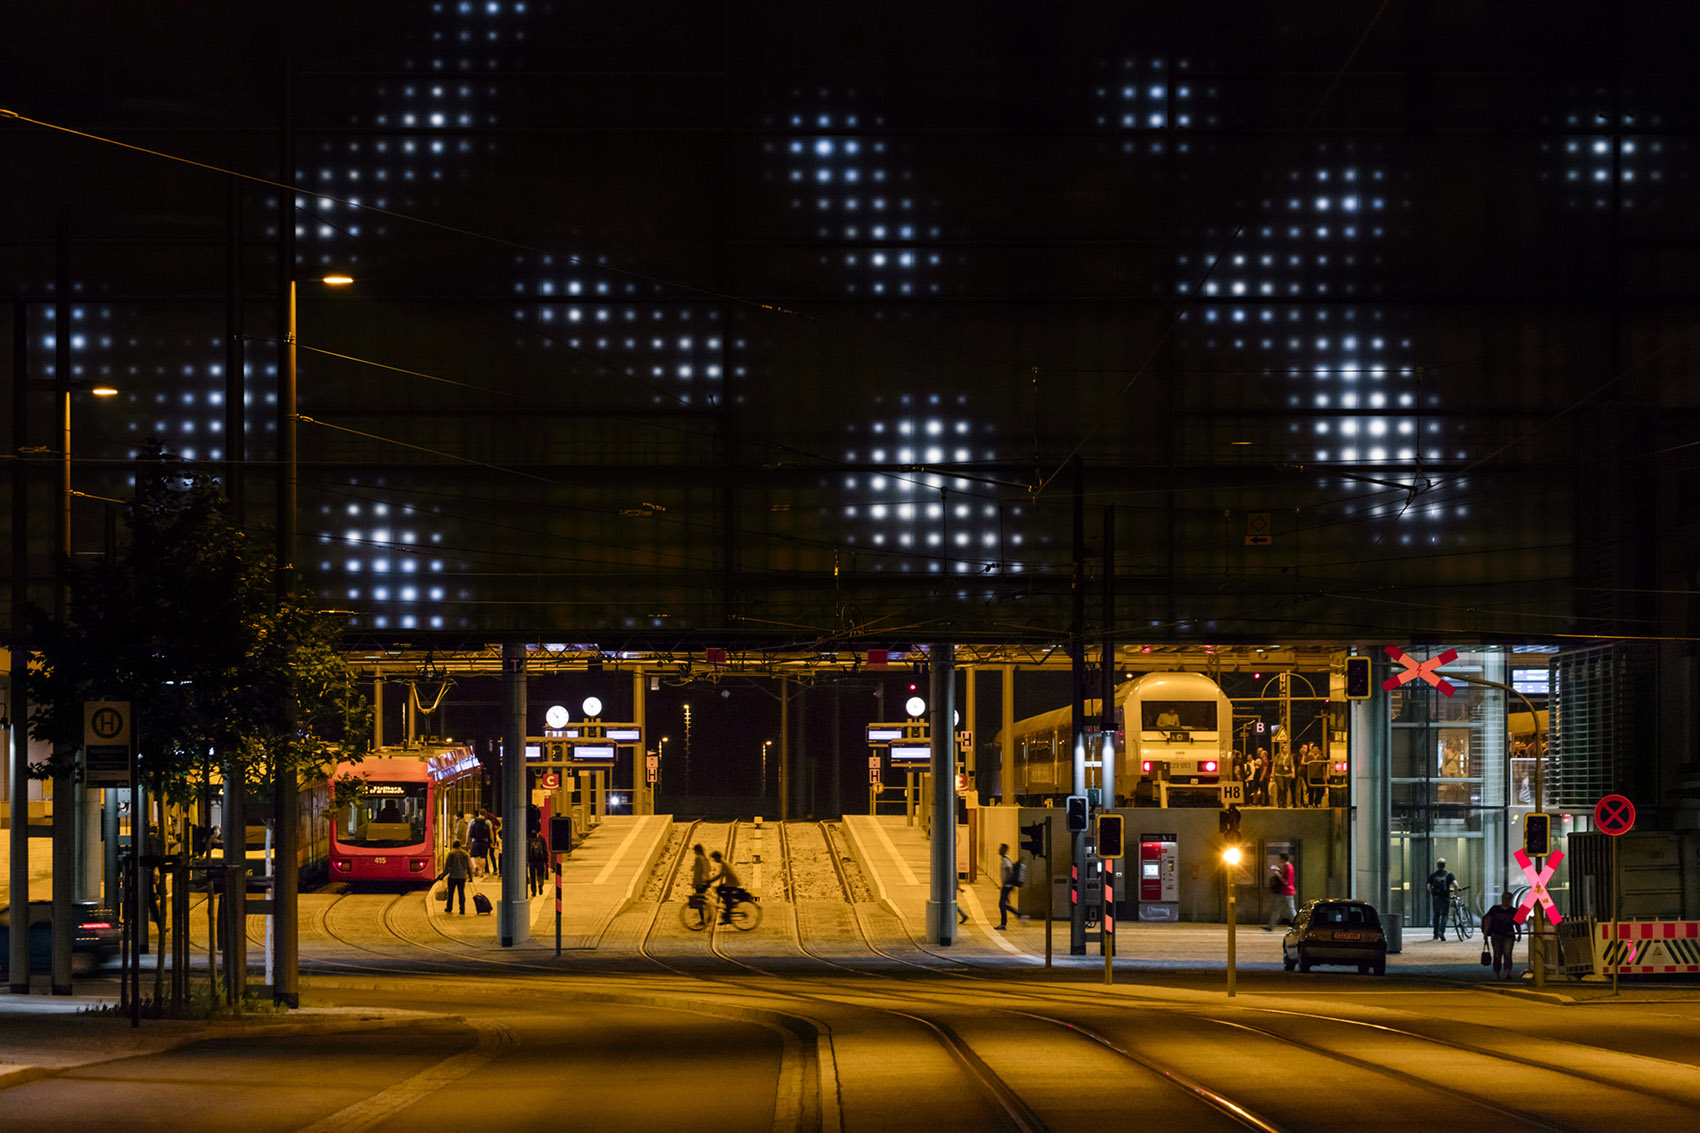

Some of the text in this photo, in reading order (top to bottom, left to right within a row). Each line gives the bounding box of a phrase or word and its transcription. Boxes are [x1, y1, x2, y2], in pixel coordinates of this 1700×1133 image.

[101, 714, 114, 731] H
[1256, 722, 1265, 733] B
[962, 732, 972, 747] H
[546, 776, 555, 785] C
[648, 768, 657, 781] H
[870, 770, 880, 782] H
[1224, 786, 1240, 799] H8
